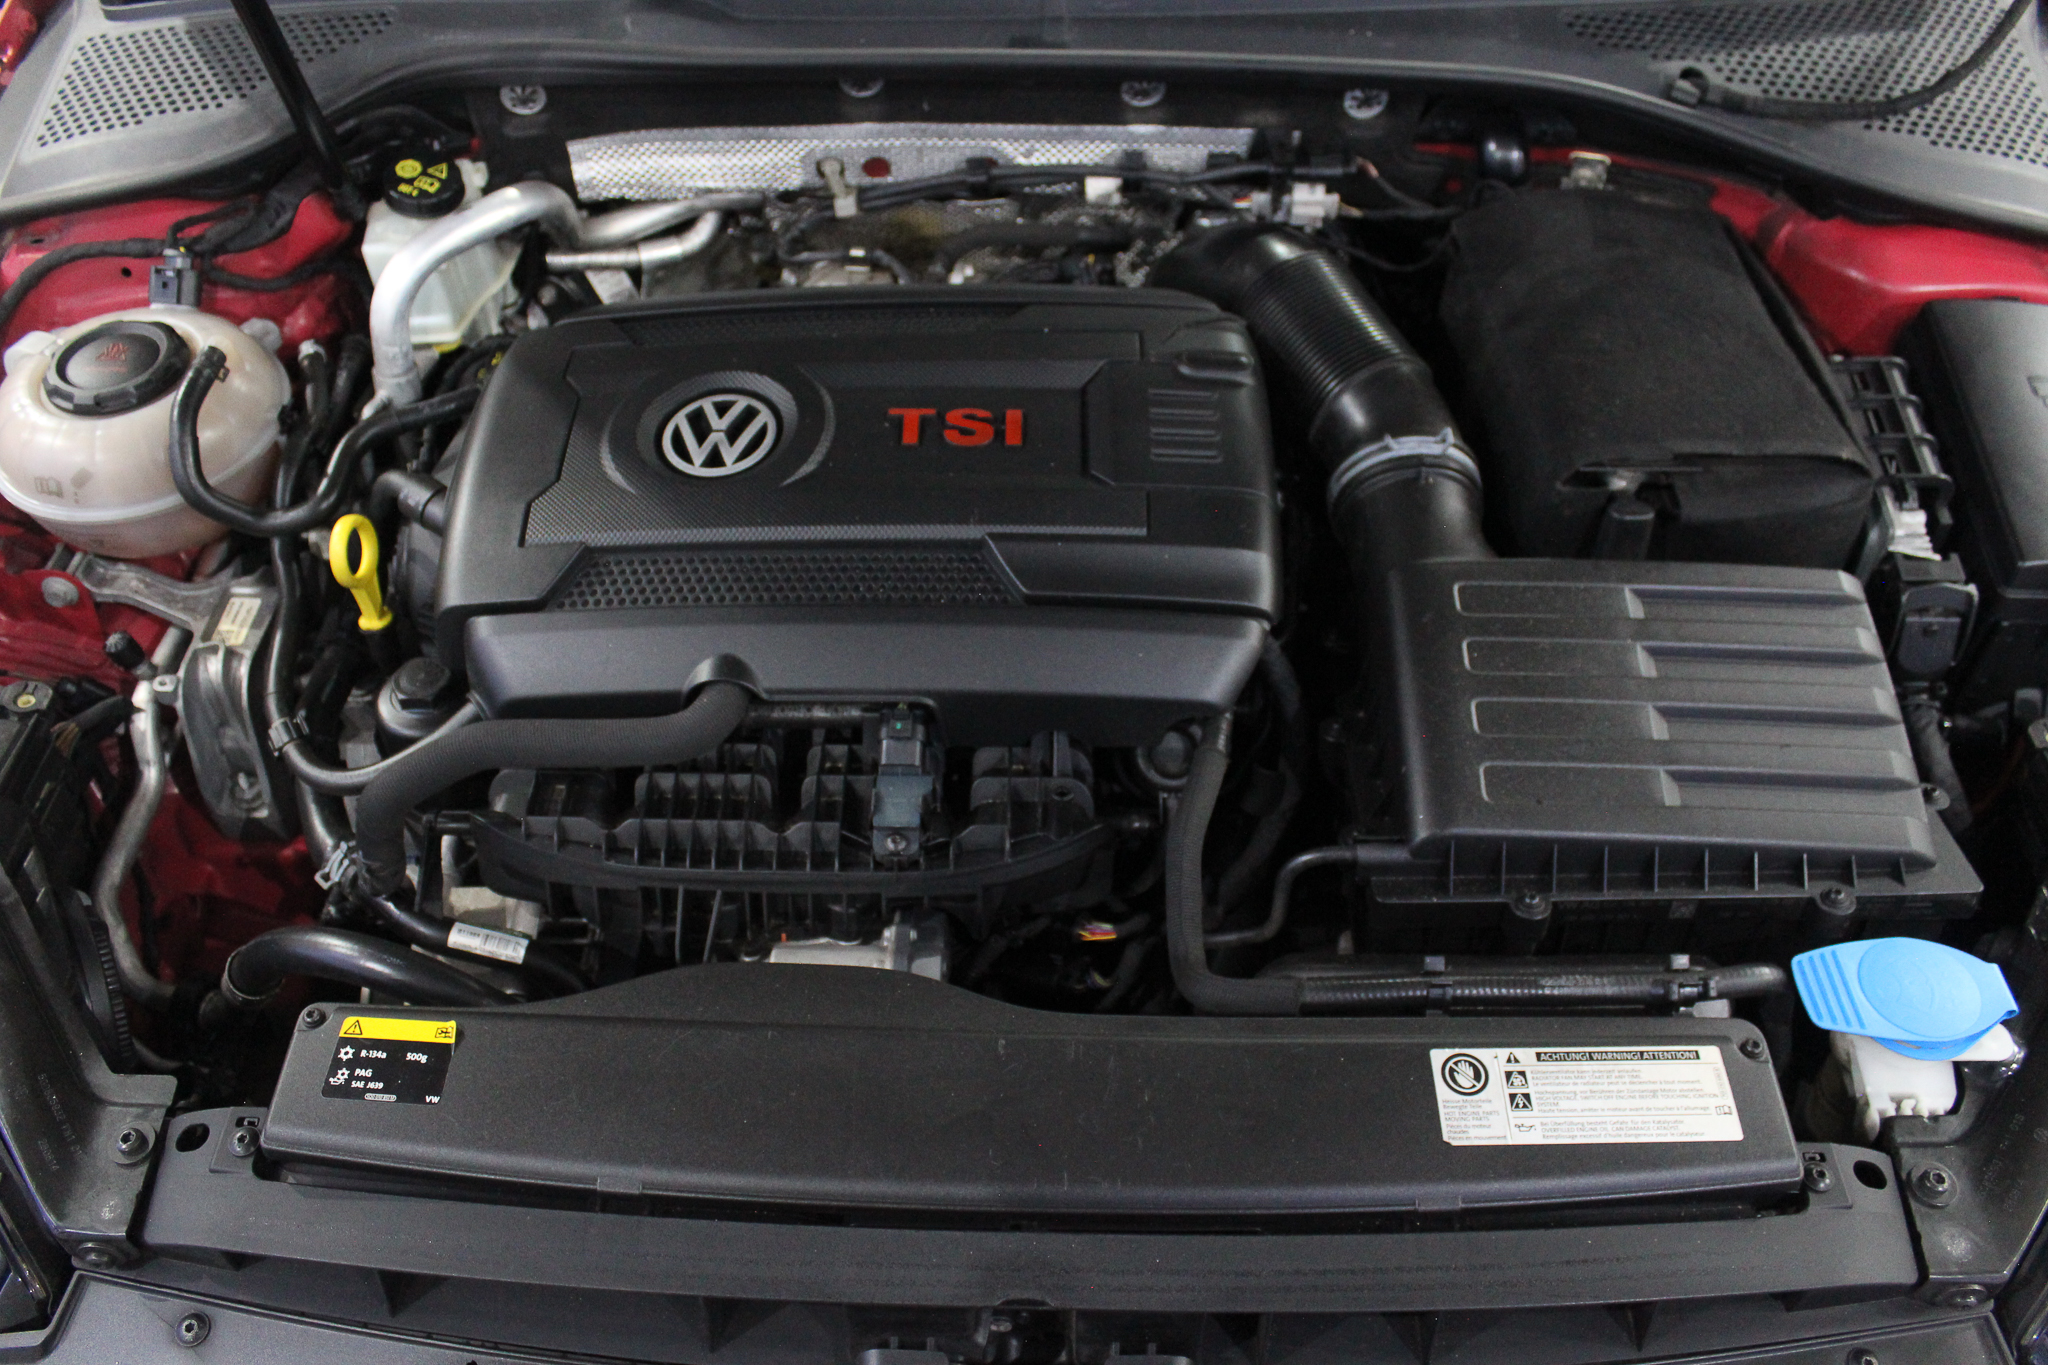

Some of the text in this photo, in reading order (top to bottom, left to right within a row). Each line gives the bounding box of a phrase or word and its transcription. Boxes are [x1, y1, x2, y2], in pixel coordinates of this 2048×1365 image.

[888, 408, 1023, 446] TSI
[360, 1049, 387, 1059] R-134a
[406, 1052, 428, 1064] 500g
[1540, 1051, 1697, 1060] ACHTUNG! WARNING! ATTENTION!
[354, 1068, 373, 1078] PAG
[366, 1081, 384, 1089] J639
[426, 1096, 440, 1104] VW
